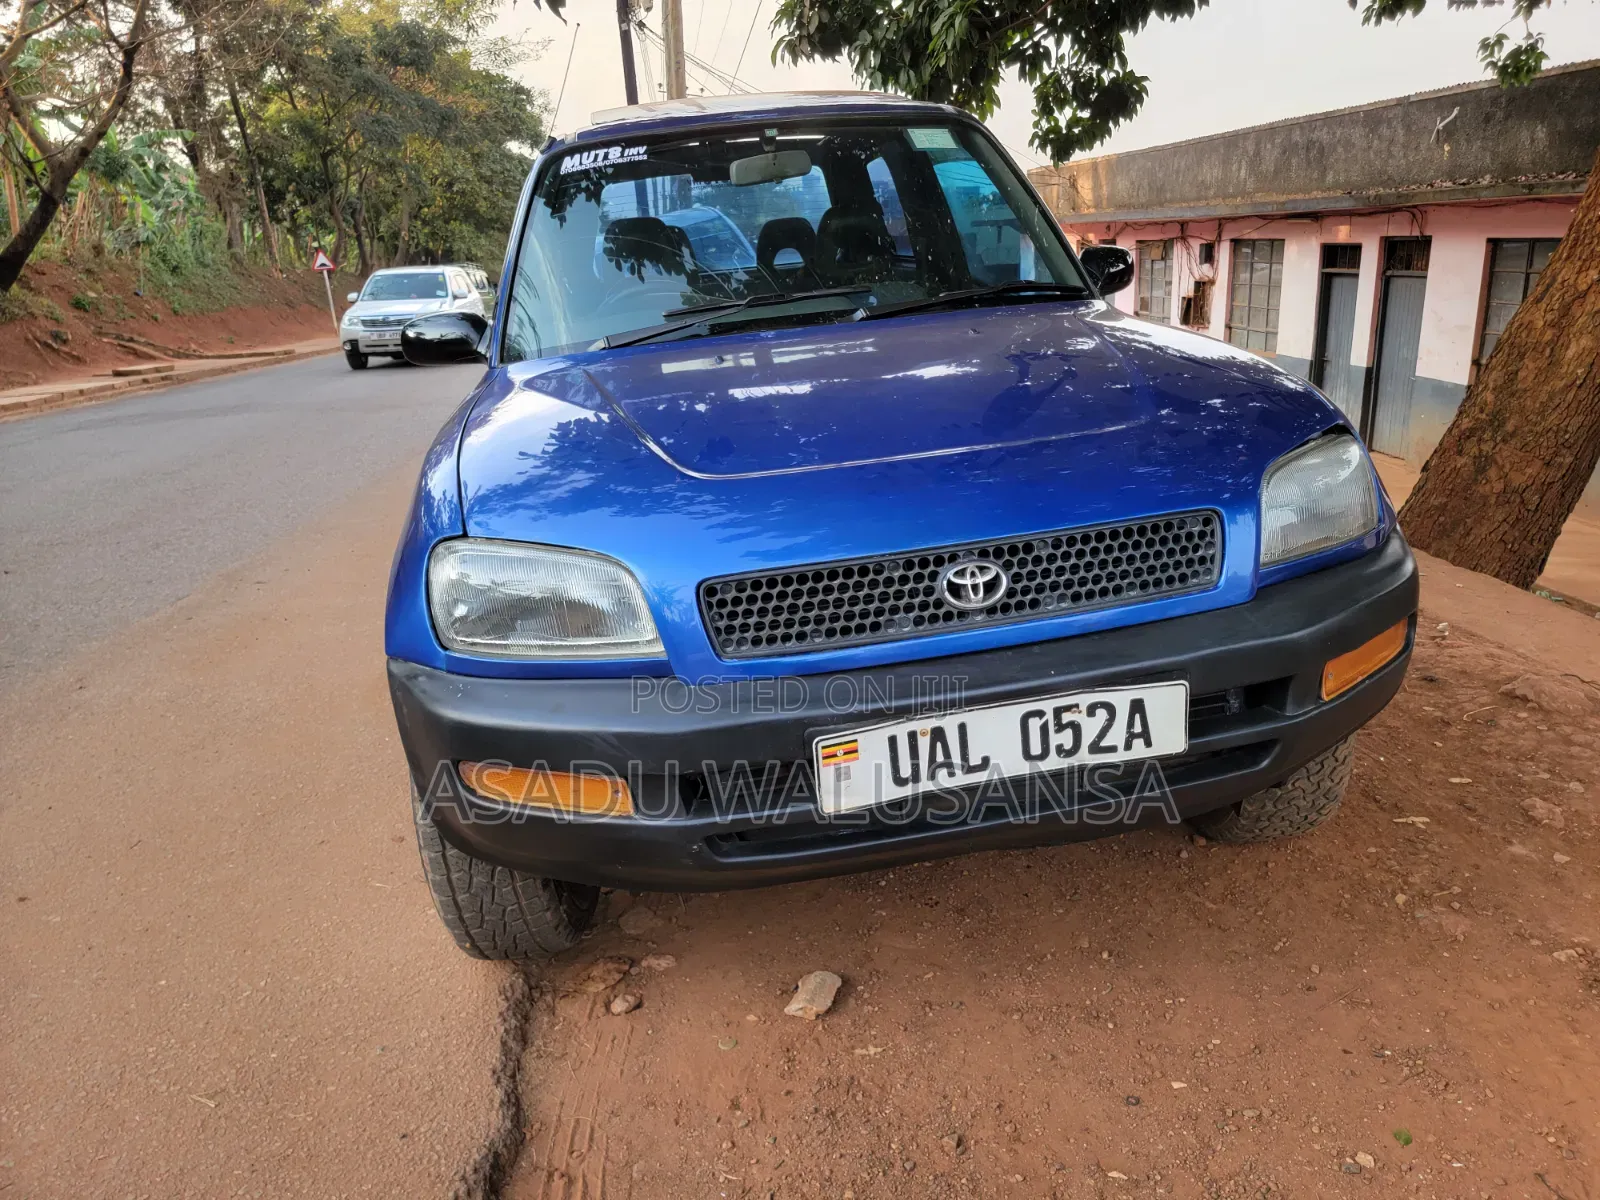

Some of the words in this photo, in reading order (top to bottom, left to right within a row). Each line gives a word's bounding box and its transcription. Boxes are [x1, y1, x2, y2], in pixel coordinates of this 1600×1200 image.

[624, 145, 648, 157] INV
[887, 721, 991, 788] UAL
[1019, 698, 1153, 763] 052A
